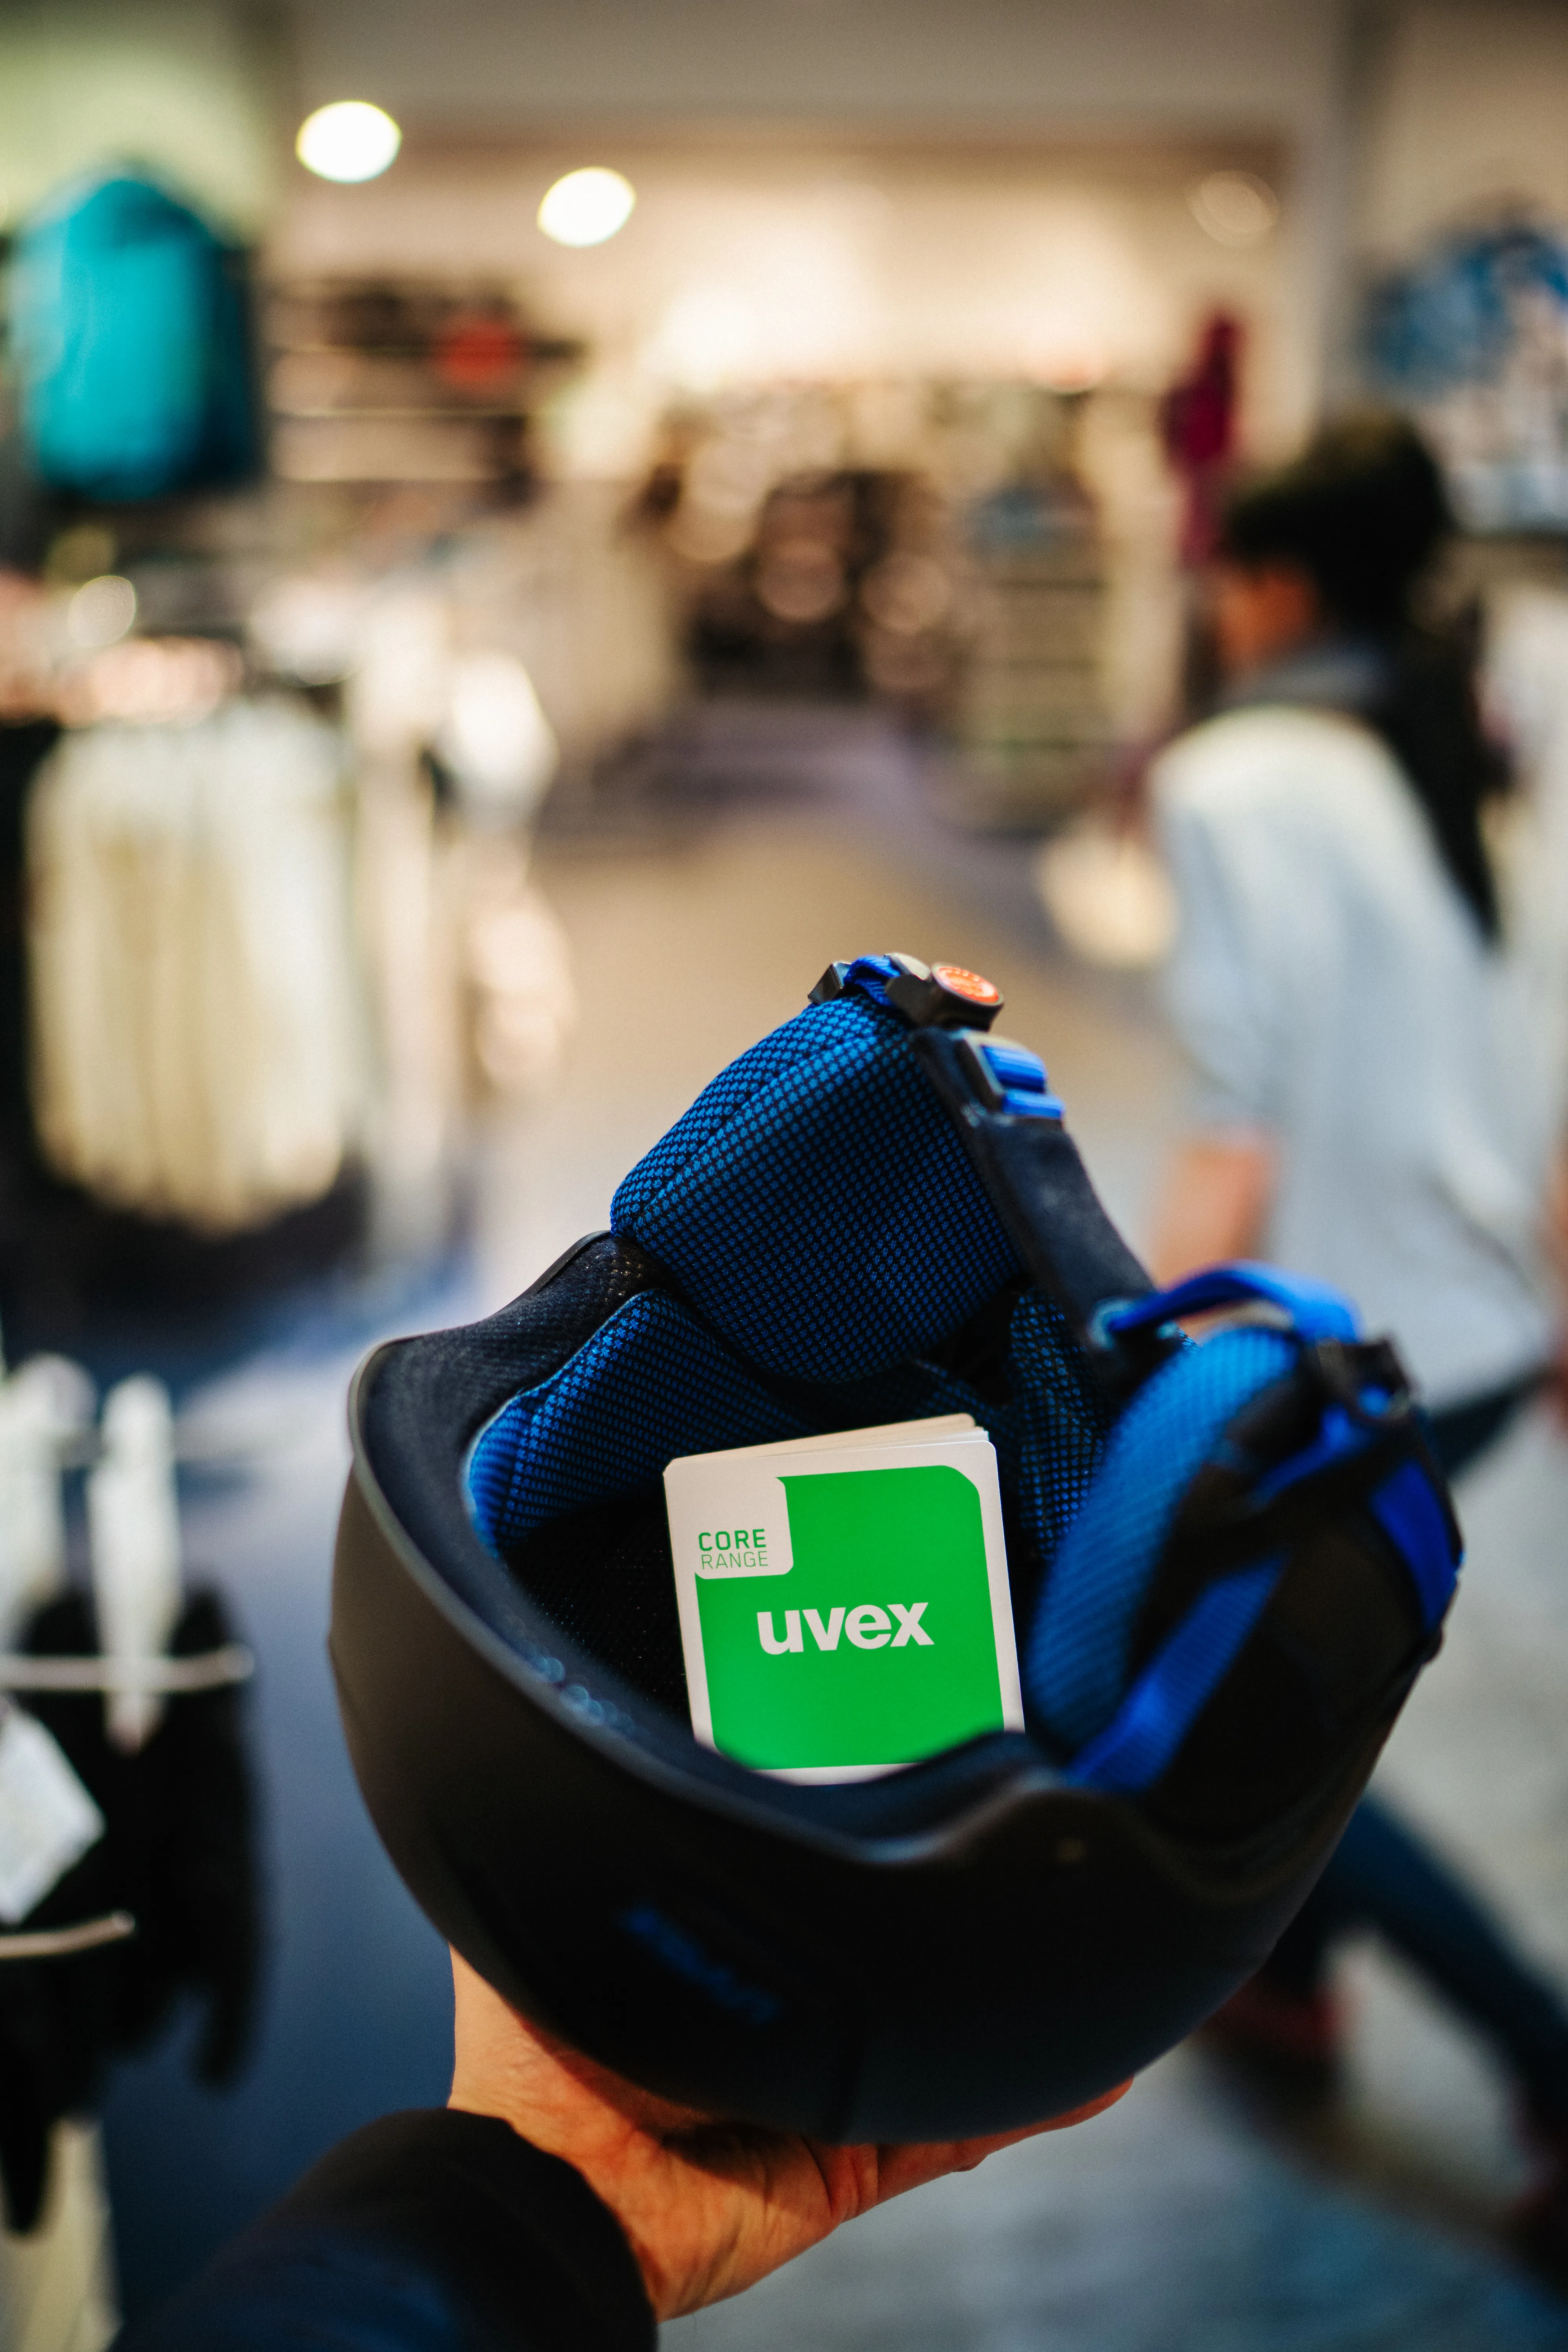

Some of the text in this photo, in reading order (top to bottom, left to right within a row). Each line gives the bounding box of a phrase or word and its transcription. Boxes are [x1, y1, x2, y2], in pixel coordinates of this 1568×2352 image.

[698, 1528, 767, 1552] CORE
[701, 1550, 768, 1570] RANGE
[757, 1602, 935, 1655] uvex
